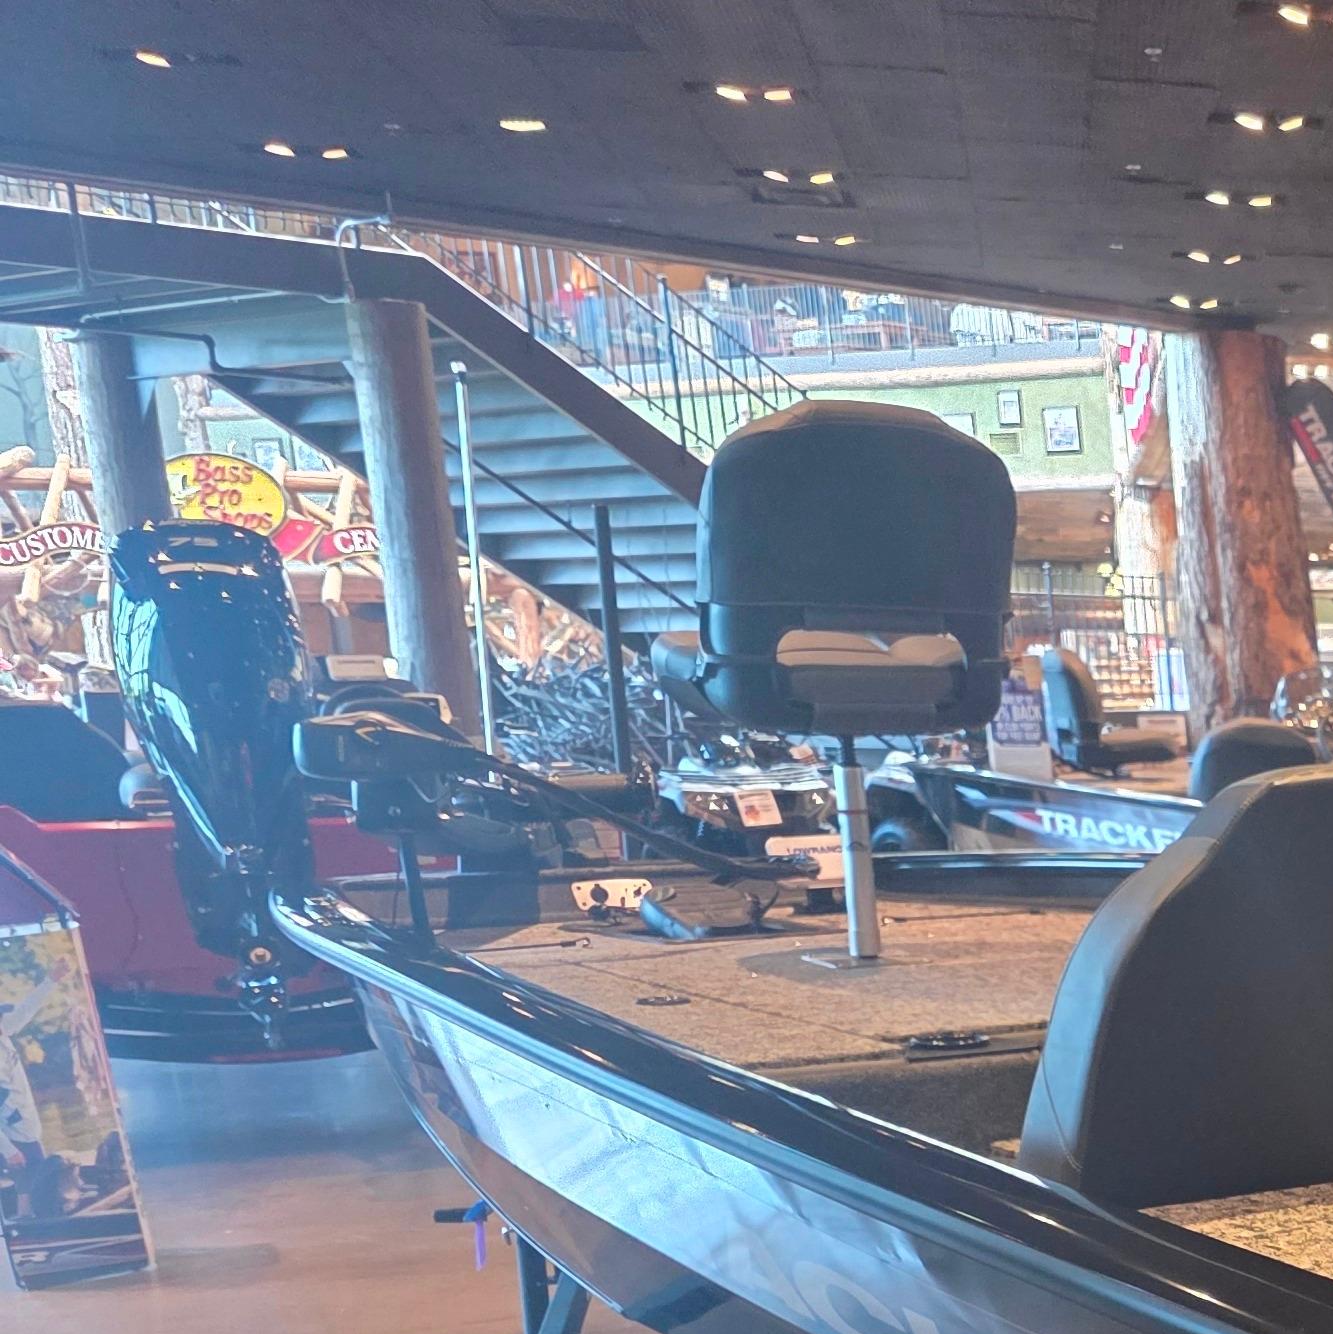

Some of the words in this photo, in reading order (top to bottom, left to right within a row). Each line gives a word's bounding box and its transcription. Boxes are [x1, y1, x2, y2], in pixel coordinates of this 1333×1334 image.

[194, 457, 253, 483] Bass
[200, 482, 242, 505] Pro
[333, 528, 381, 554] CEN
[1034, 808, 1182, 851] TRACKE
